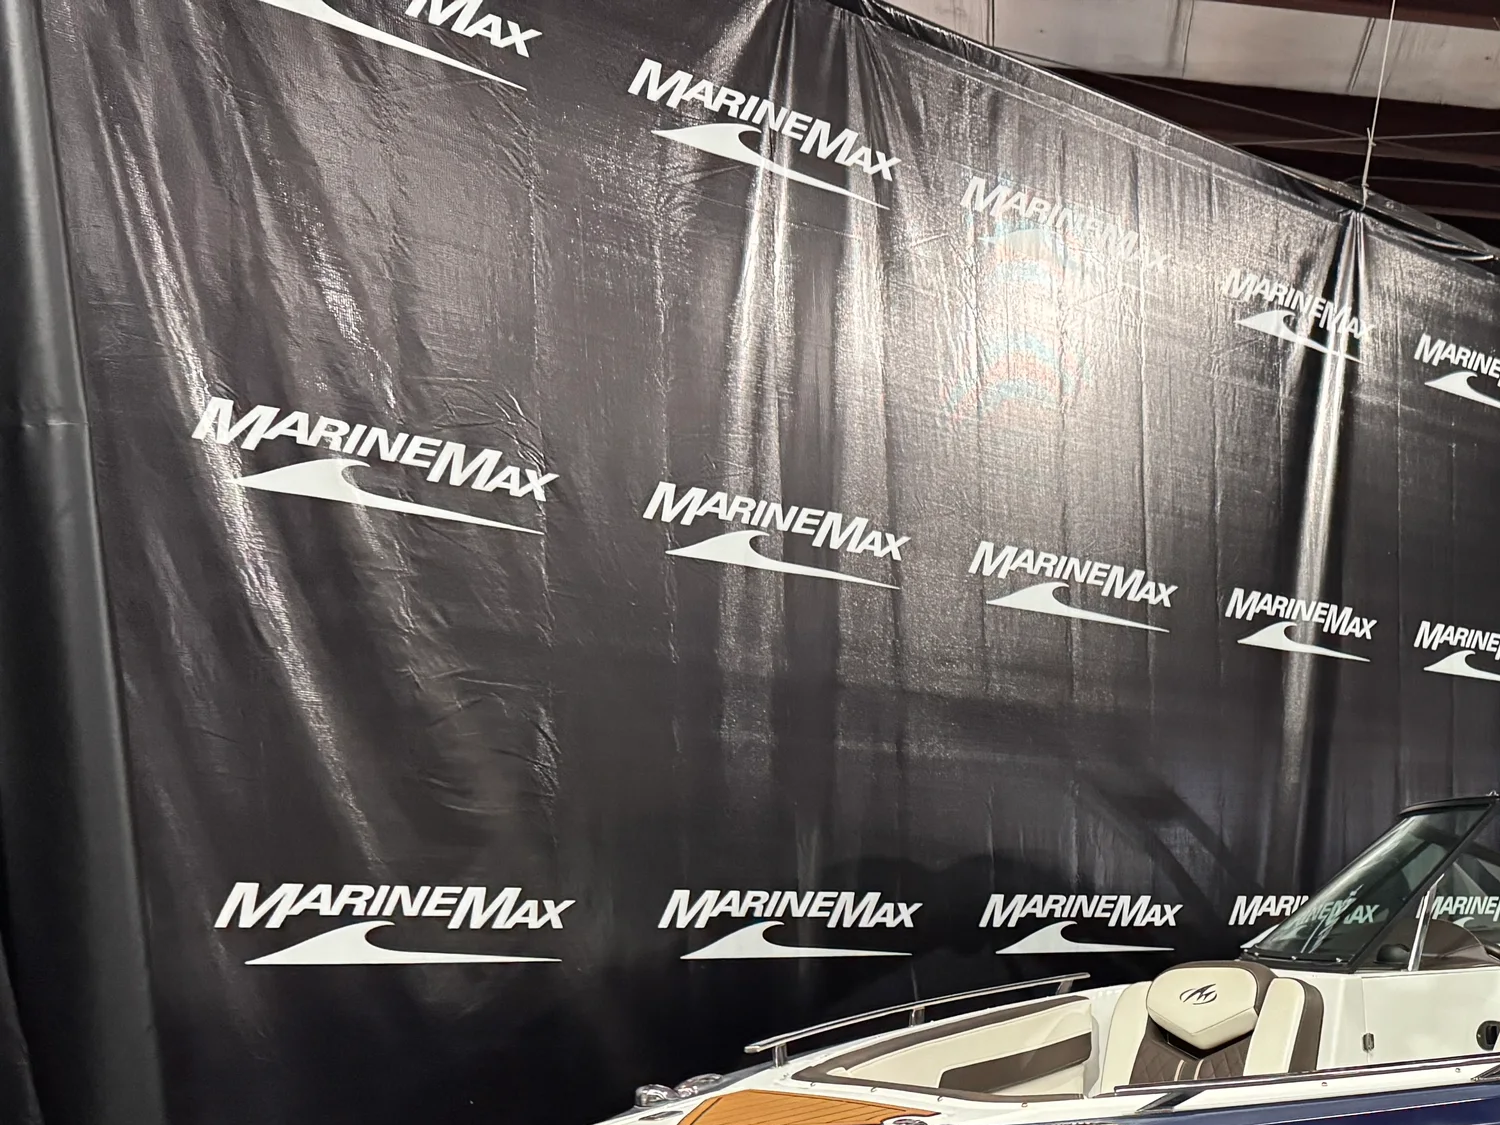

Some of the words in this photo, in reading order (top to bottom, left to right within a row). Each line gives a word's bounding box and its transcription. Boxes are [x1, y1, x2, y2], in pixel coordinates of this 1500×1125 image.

[628, 58, 901, 182] MARINEMAX
[192, 398, 559, 502] MARINEMAX
[643, 482, 911, 561] MARINEMAX
[968, 541, 1178, 608] MARINEMAX
[1225, 588, 1377, 640] MARINEMAX
[215, 882, 575, 930] MARINEMAX
[657, 889, 923, 930] MARINEMAX
[979, 894, 1183, 928] MARINEMAX
